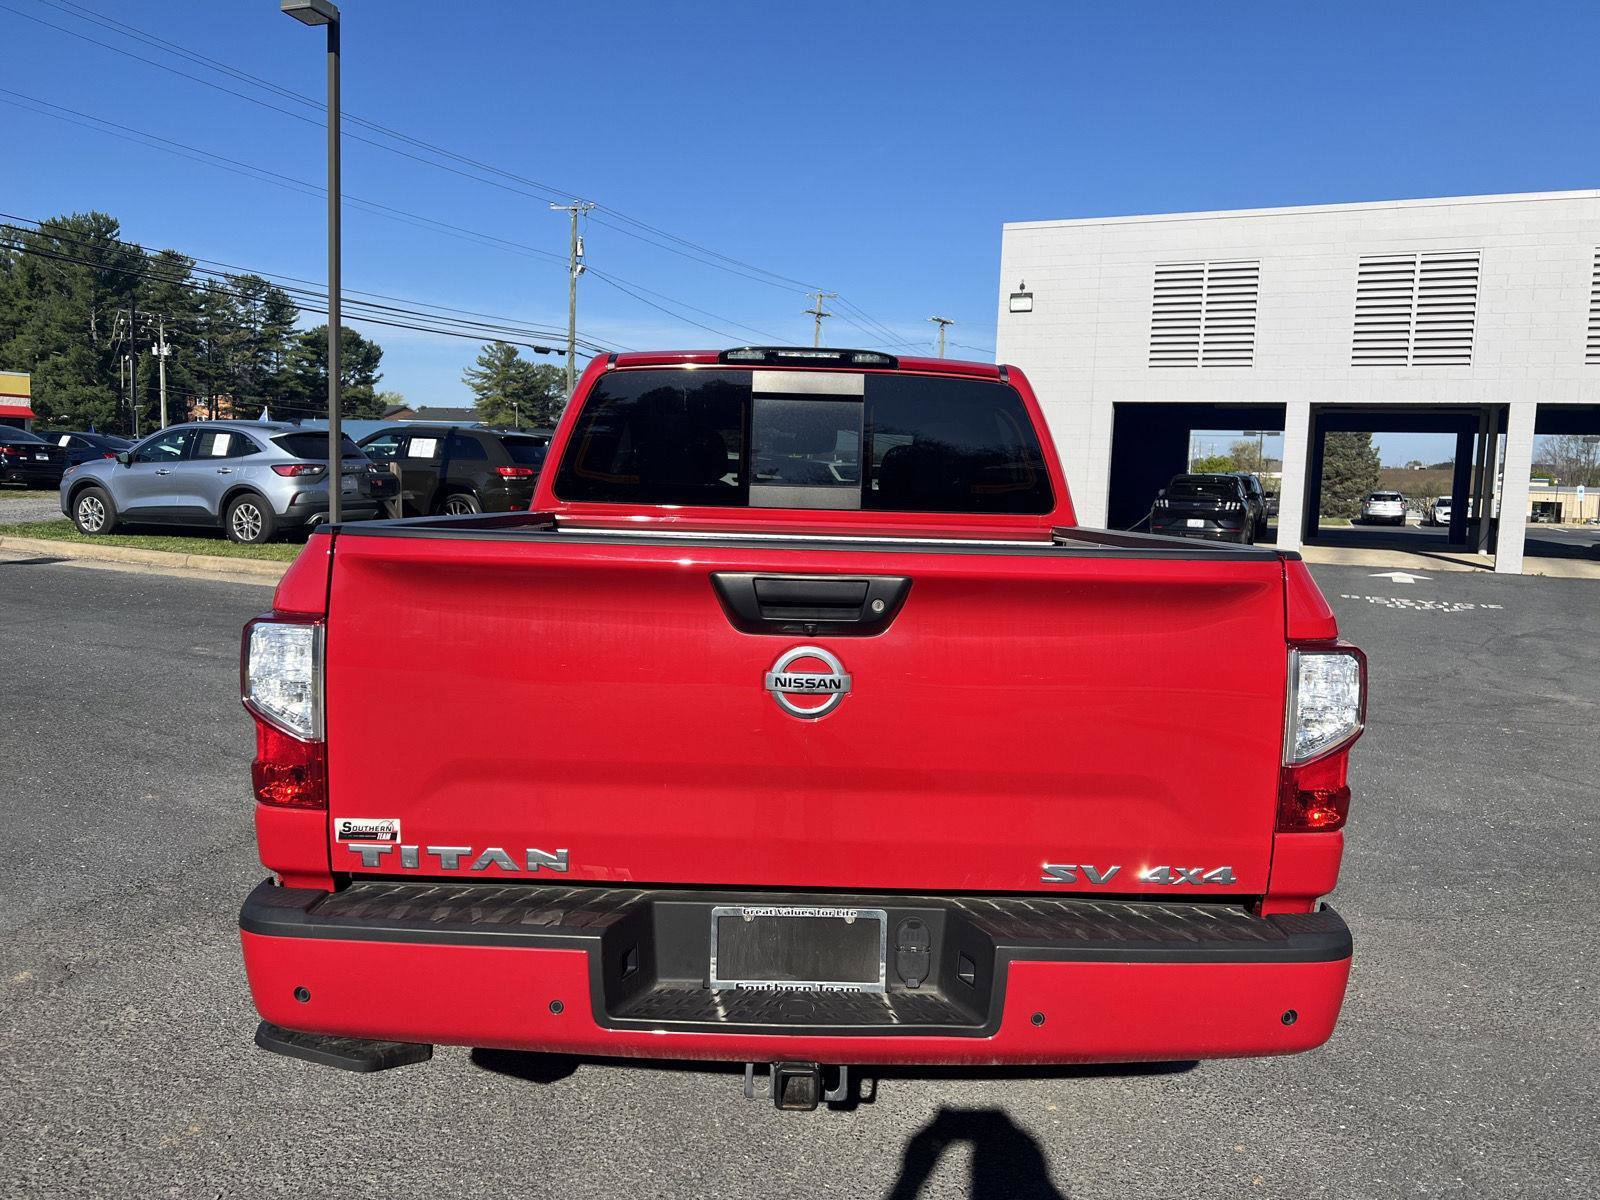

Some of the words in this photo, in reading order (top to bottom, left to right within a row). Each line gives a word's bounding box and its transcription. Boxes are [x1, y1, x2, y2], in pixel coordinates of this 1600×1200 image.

[774, 677, 841, 690] NISSAN
[342, 821, 392, 833] SOUTHERN
[377, 832, 392, 840] TEAM
[348, 844, 569, 872] TITAN
[1040, 864, 1122, 885] SV
[742, 908, 774, 917] Great
[776, 908, 815, 917] Values
[817, 909, 833, 917] for
[836, 909, 858, 918] Life
